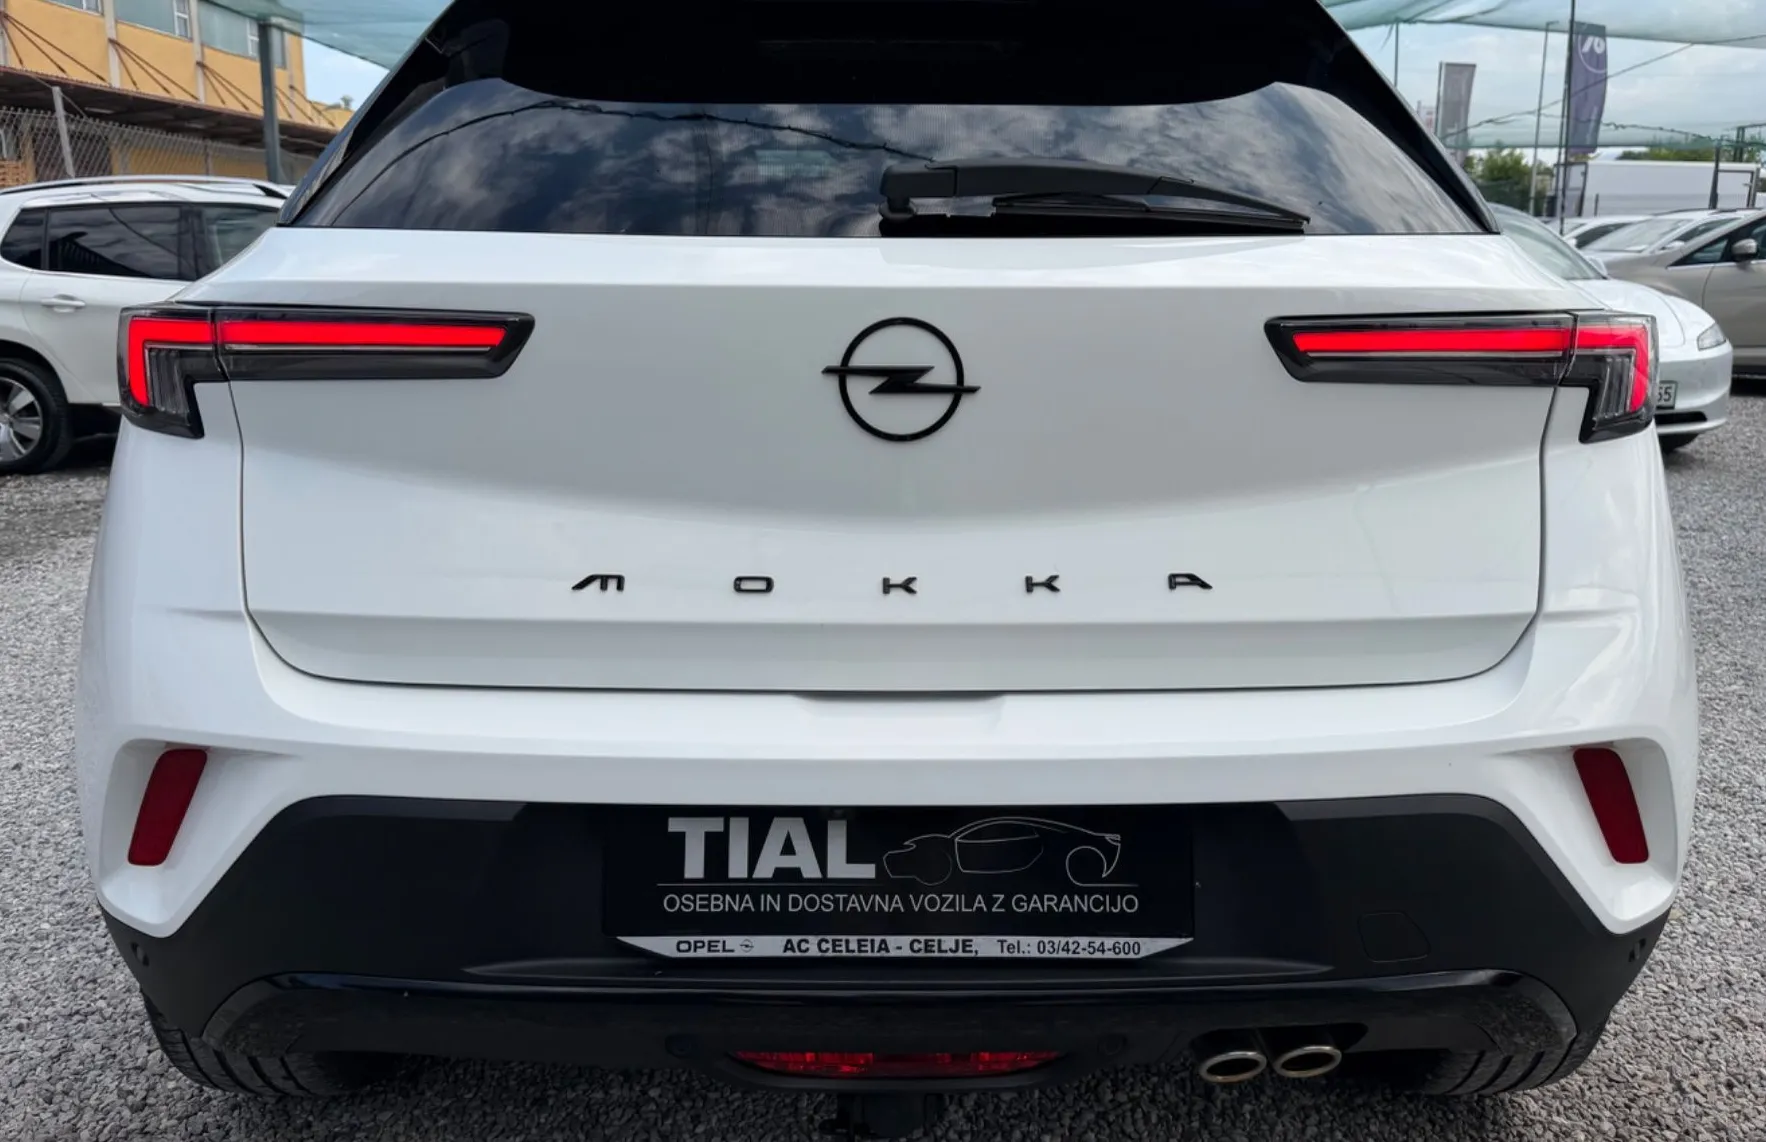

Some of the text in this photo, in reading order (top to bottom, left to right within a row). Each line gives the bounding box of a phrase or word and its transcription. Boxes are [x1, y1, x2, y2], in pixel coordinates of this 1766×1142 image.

[571, 573, 1213, 595] MOKKA
[667, 817, 876, 879] TIAL
[663, 893, 1139, 913] OSEBNA IN DOSTAVNA VOZILA Z GARANCIJO
[675, 939, 736, 954] OPEL
[782, 938, 810, 954] AC
[816, 938, 891, 954] CELEIA
[908, 938, 979, 957] CELJE,
[996, 939, 1142, 956] Tel.: 03/42-54-600
